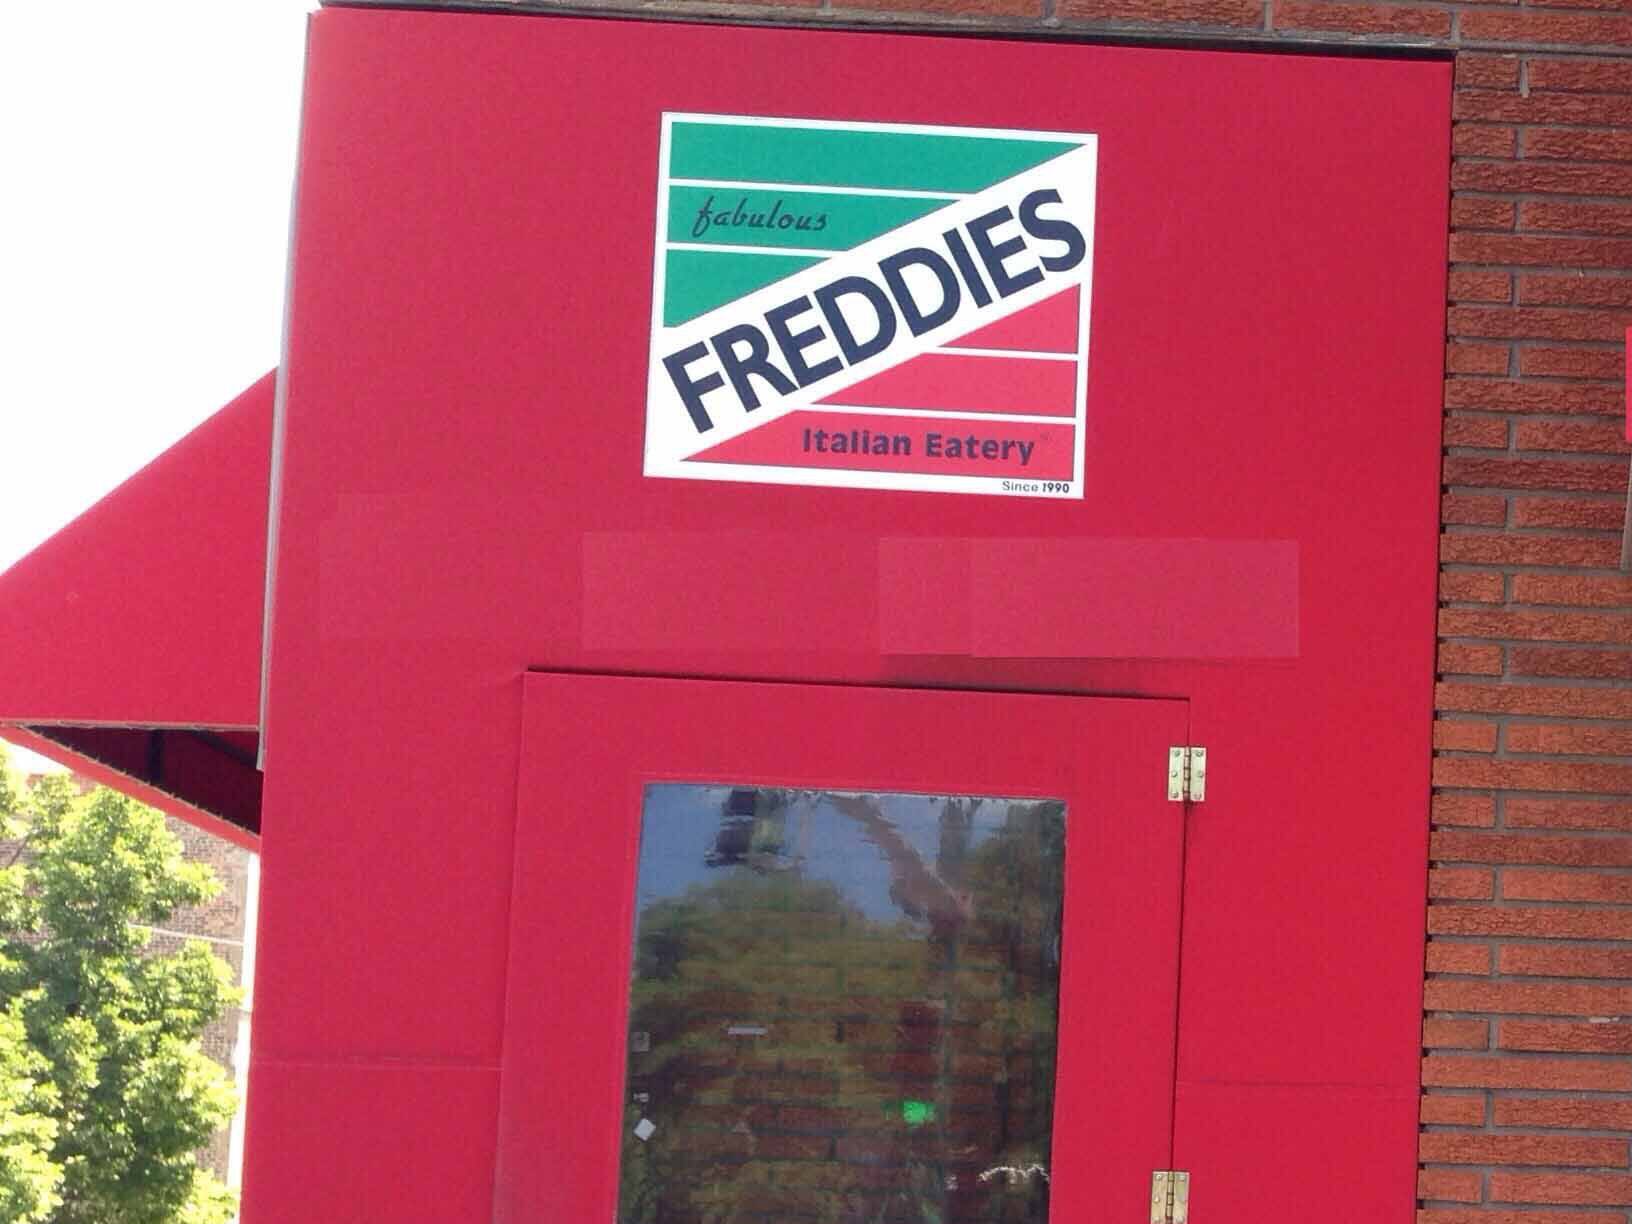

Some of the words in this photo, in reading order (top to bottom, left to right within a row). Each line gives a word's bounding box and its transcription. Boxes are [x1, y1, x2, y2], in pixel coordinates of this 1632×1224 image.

[692, 195, 829, 238] fabulous
[661, 188, 1087, 434] FREDDIES
[802, 428, 912, 457] Italian
[925, 433, 1036, 466] Eatery
[1002, 480, 1039, 493] Since
[1042, 482, 1070, 494] 1990
